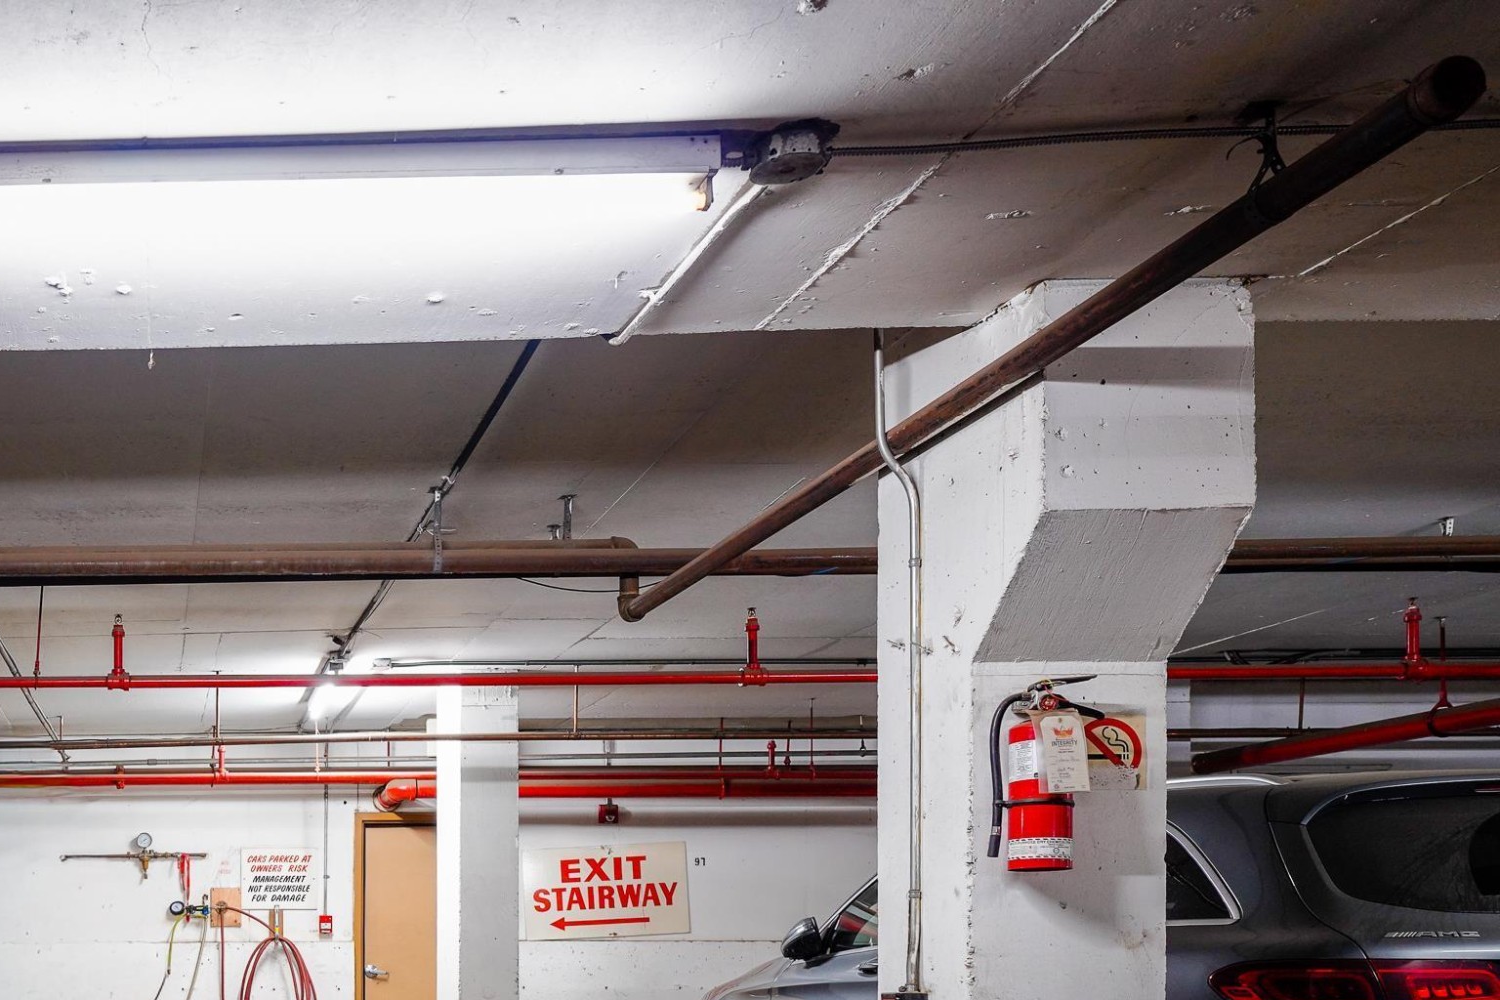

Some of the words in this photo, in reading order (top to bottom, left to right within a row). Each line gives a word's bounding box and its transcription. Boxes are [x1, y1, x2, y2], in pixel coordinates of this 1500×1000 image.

[1051, 739, 1078, 747] INTEGRITY
[247, 855, 268, 863] CARS
[269, 855, 300, 863] PARKED
[301, 855, 312, 863] AT
[250, 864, 283, 873] OWNERS
[288, 864, 308, 873] RISK
[560, 855, 647, 884] EXIT
[252, 875, 306, 883] MANAGEMENT
[247, 885, 263, 893] NOT
[264, 885, 311, 893] RESPONSIBLE
[251, 894, 268, 902] FOR
[270, 894, 306, 902] DAMAGE
[533, 881, 678, 913] STAIRWAY
